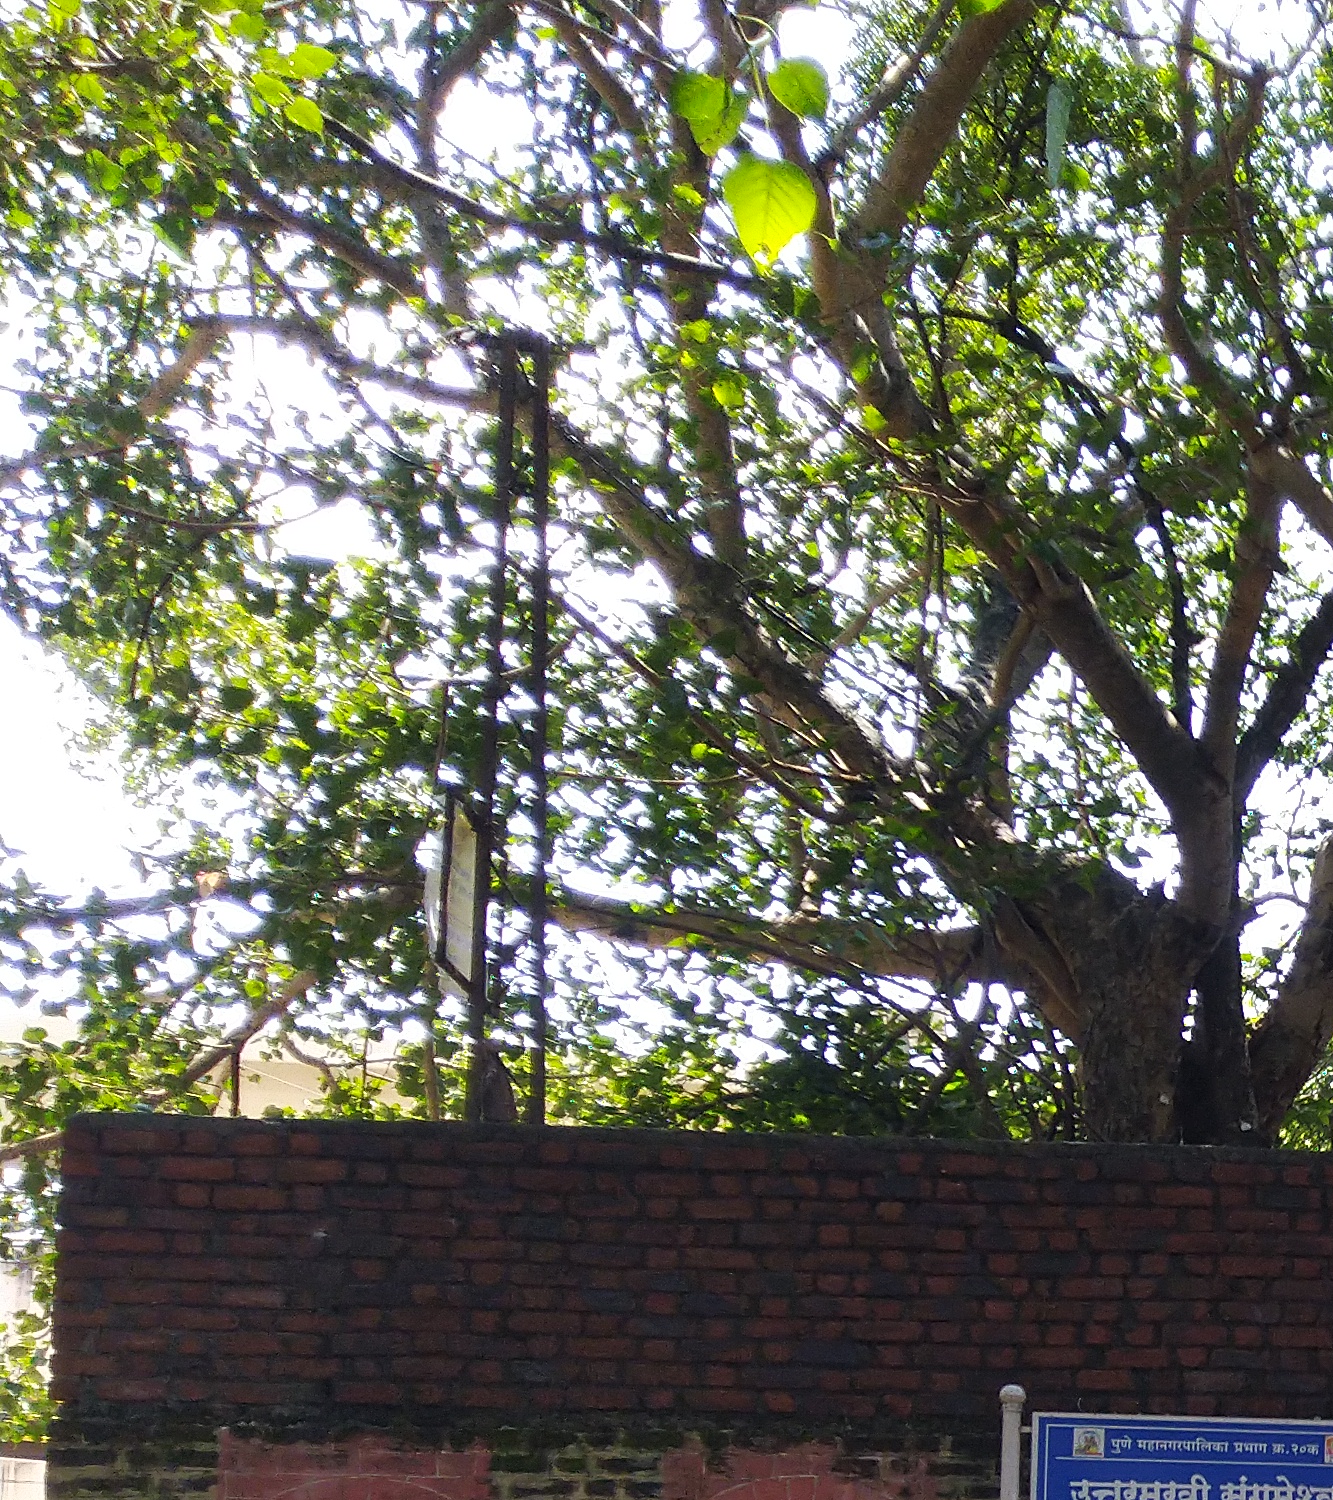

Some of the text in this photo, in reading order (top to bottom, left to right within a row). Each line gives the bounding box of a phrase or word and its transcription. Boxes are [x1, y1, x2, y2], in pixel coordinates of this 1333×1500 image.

[1111, 1435, 1132, 1453] पुणे
[1136, 1437, 1229, 1453] महानगरपालिका
[1233, 1441, 1268, 1453] प्रभाग
